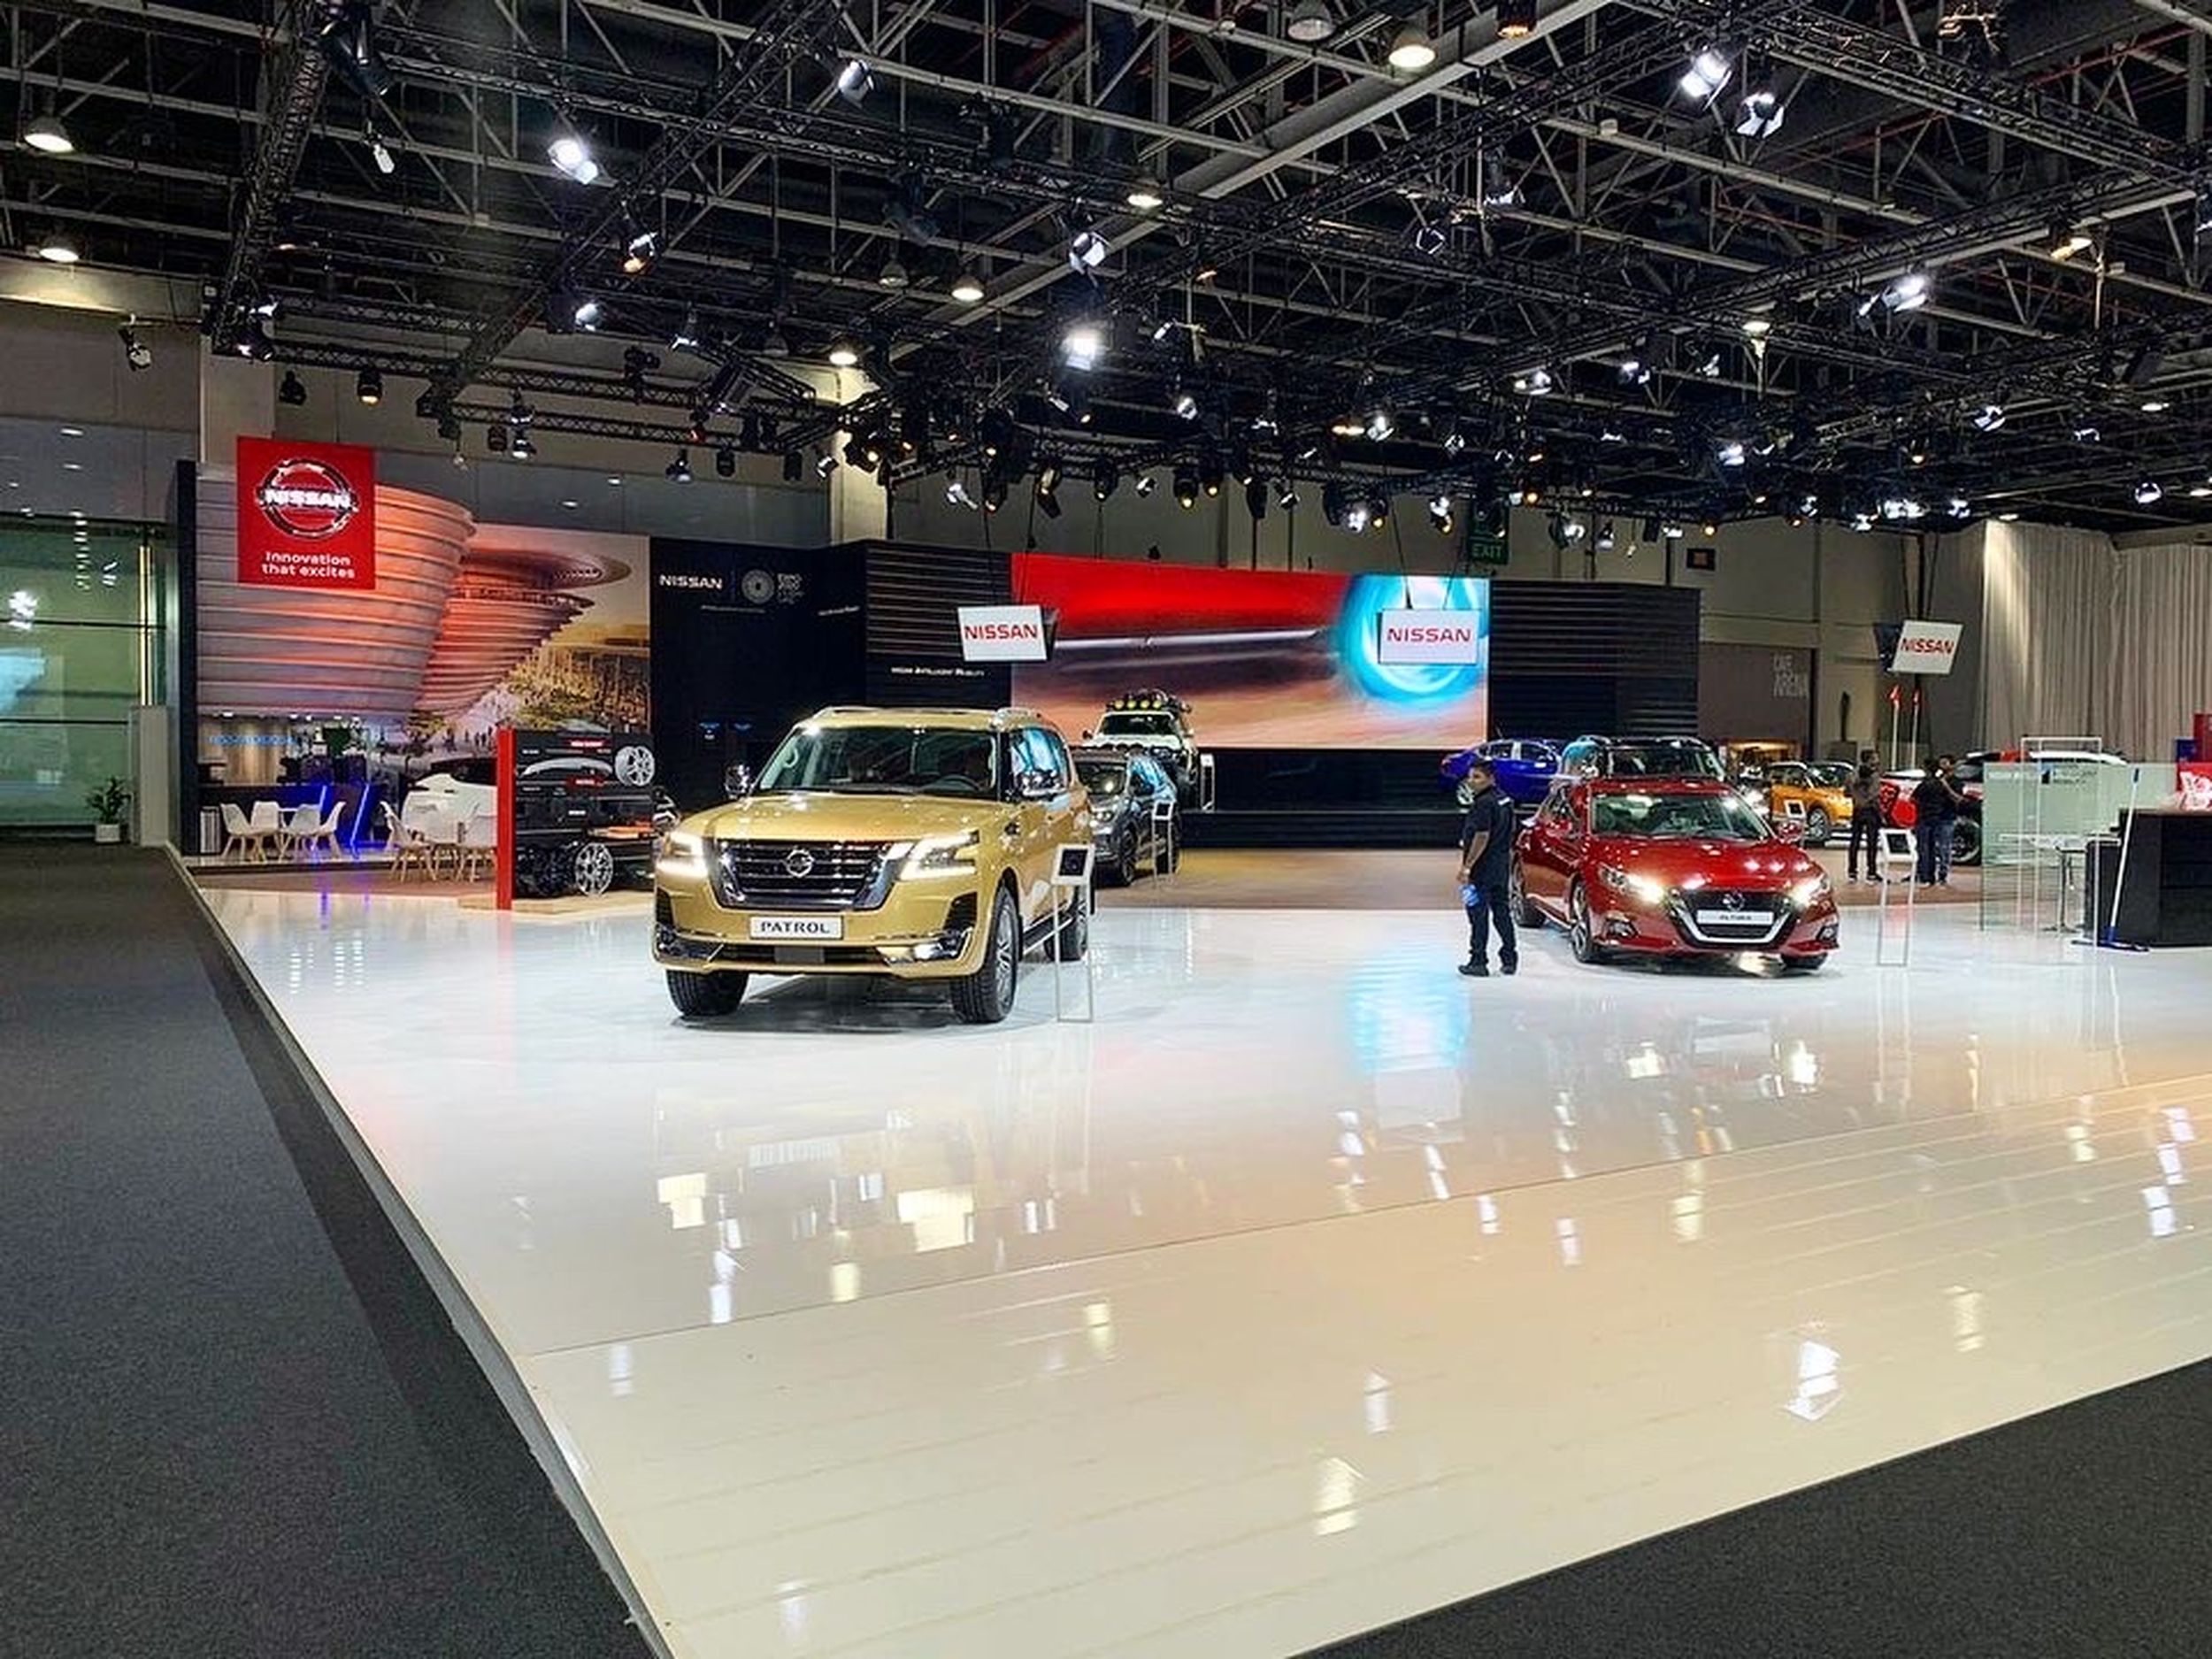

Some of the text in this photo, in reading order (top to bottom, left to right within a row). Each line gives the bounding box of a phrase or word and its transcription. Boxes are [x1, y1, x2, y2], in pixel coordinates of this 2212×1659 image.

[265, 489, 351, 509] NISSAN
[265, 551, 351, 566] Innovation
[1472, 543, 1502, 558] EXIT
[261, 563, 355, 579] that excites
[659, 574, 723, 590] NISSAN
[964, 624, 1038, 640] NISSAN
[1387, 627, 1471, 642] NISSAN
[1901, 637, 1955, 654] NISSAN
[761, 921, 831, 934] PATROL
